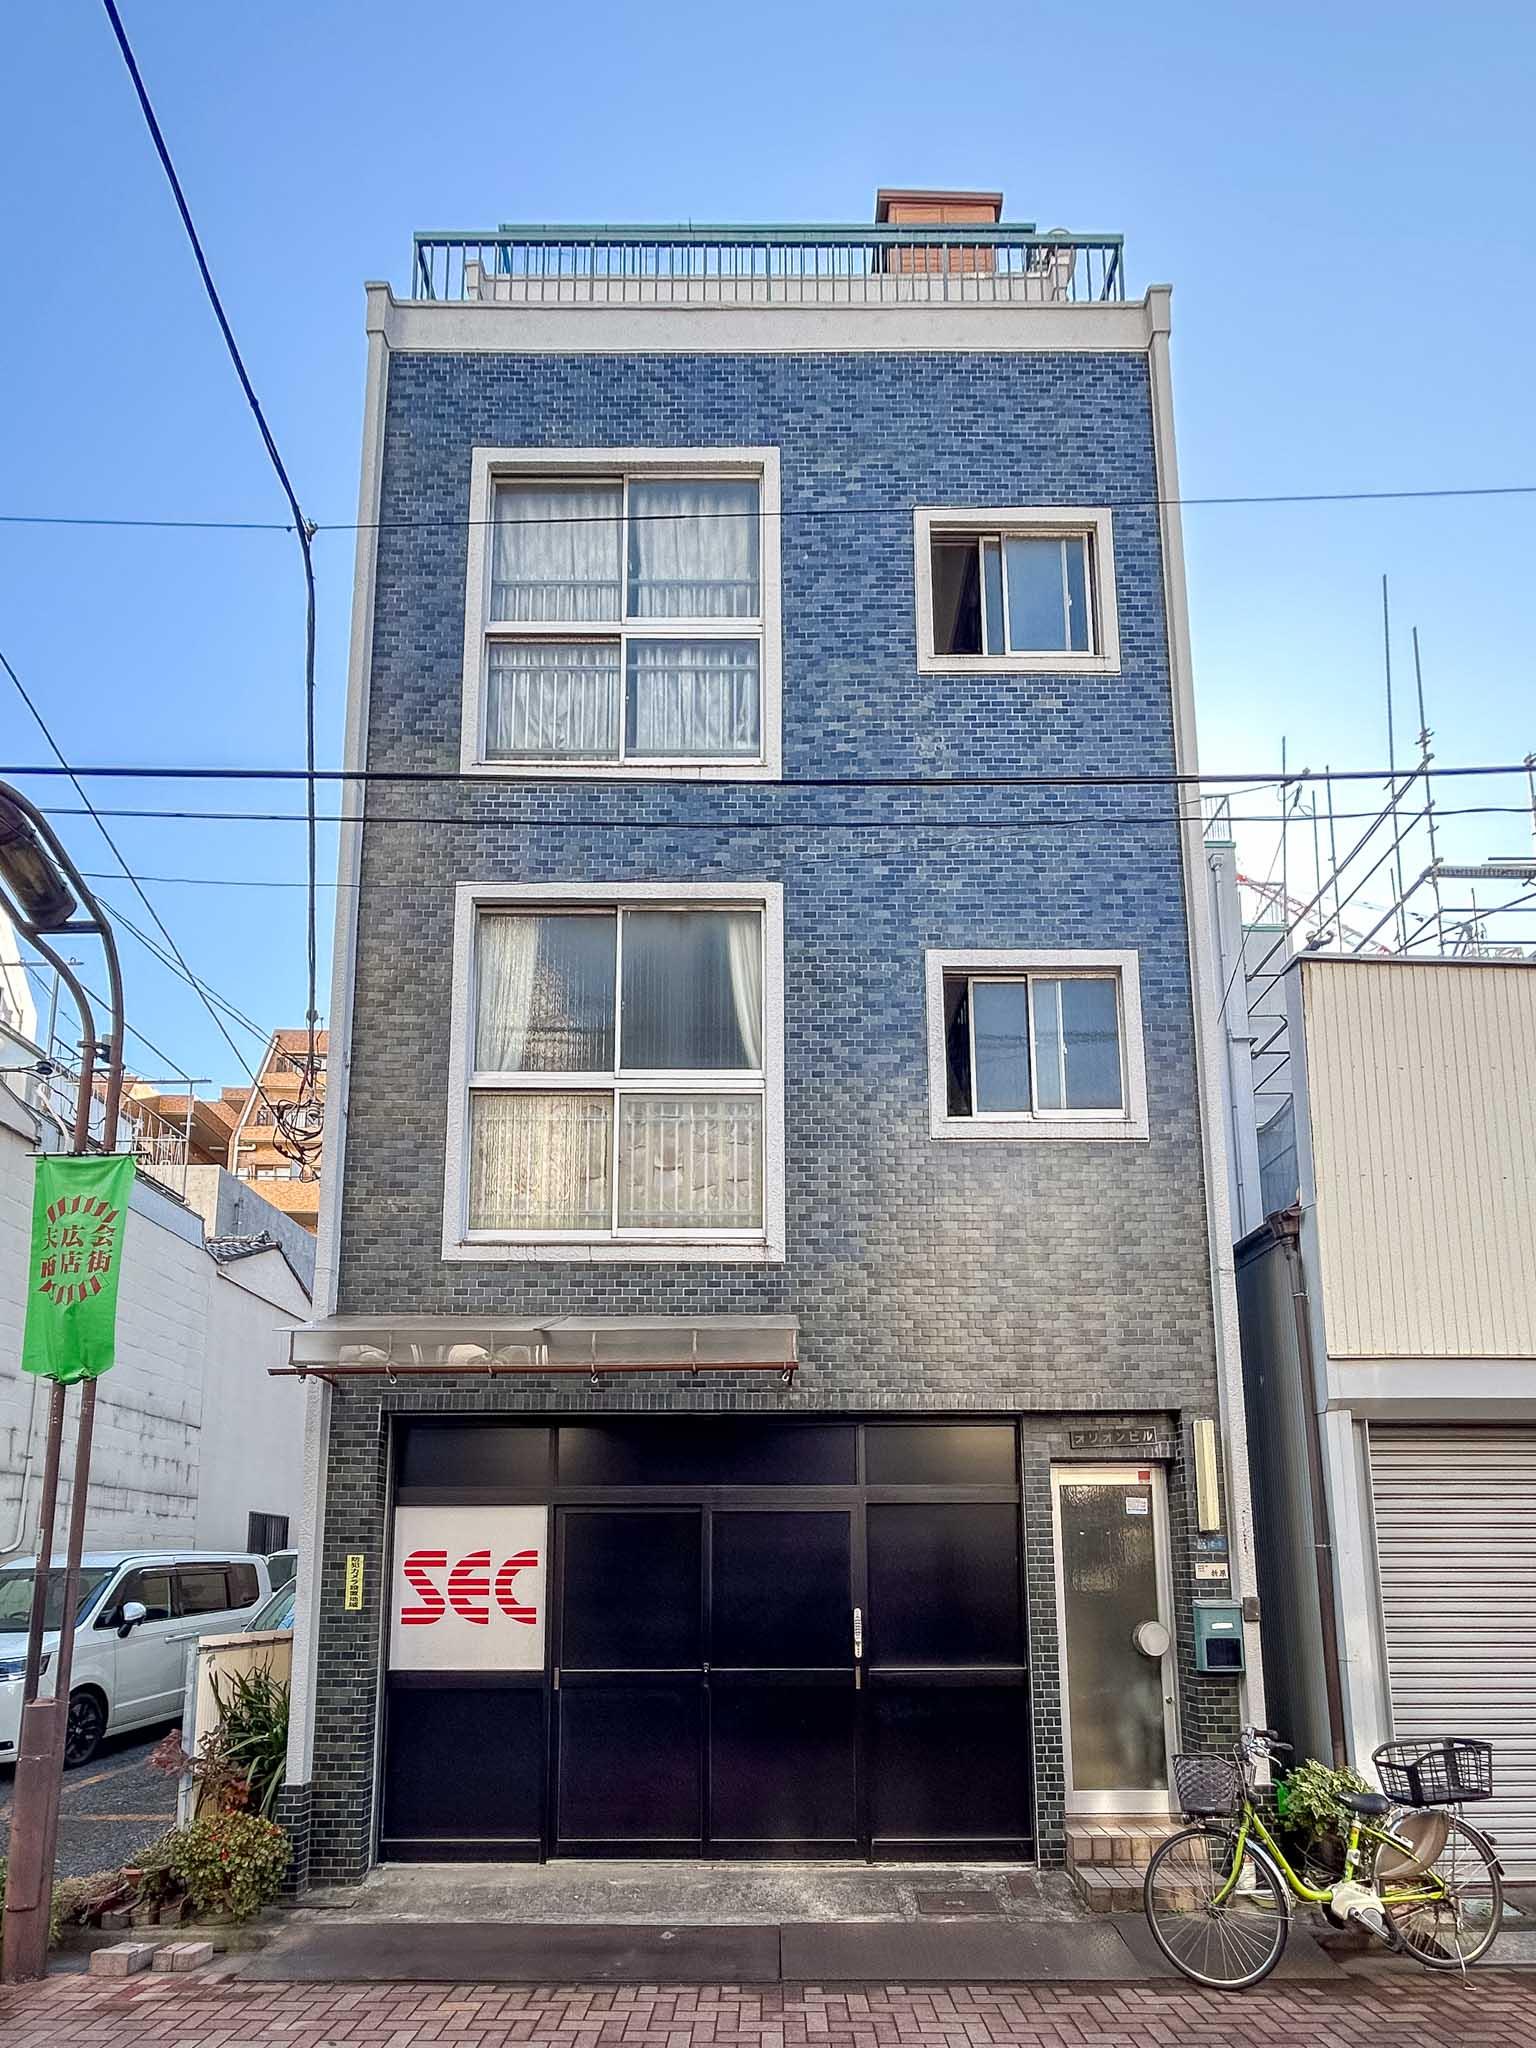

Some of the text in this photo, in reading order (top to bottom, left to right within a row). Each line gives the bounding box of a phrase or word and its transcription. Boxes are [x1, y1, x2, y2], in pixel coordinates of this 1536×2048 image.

[1075, 1430, 1153, 1444] オリオンビル
[401, 1550, 538, 1625] SEC
